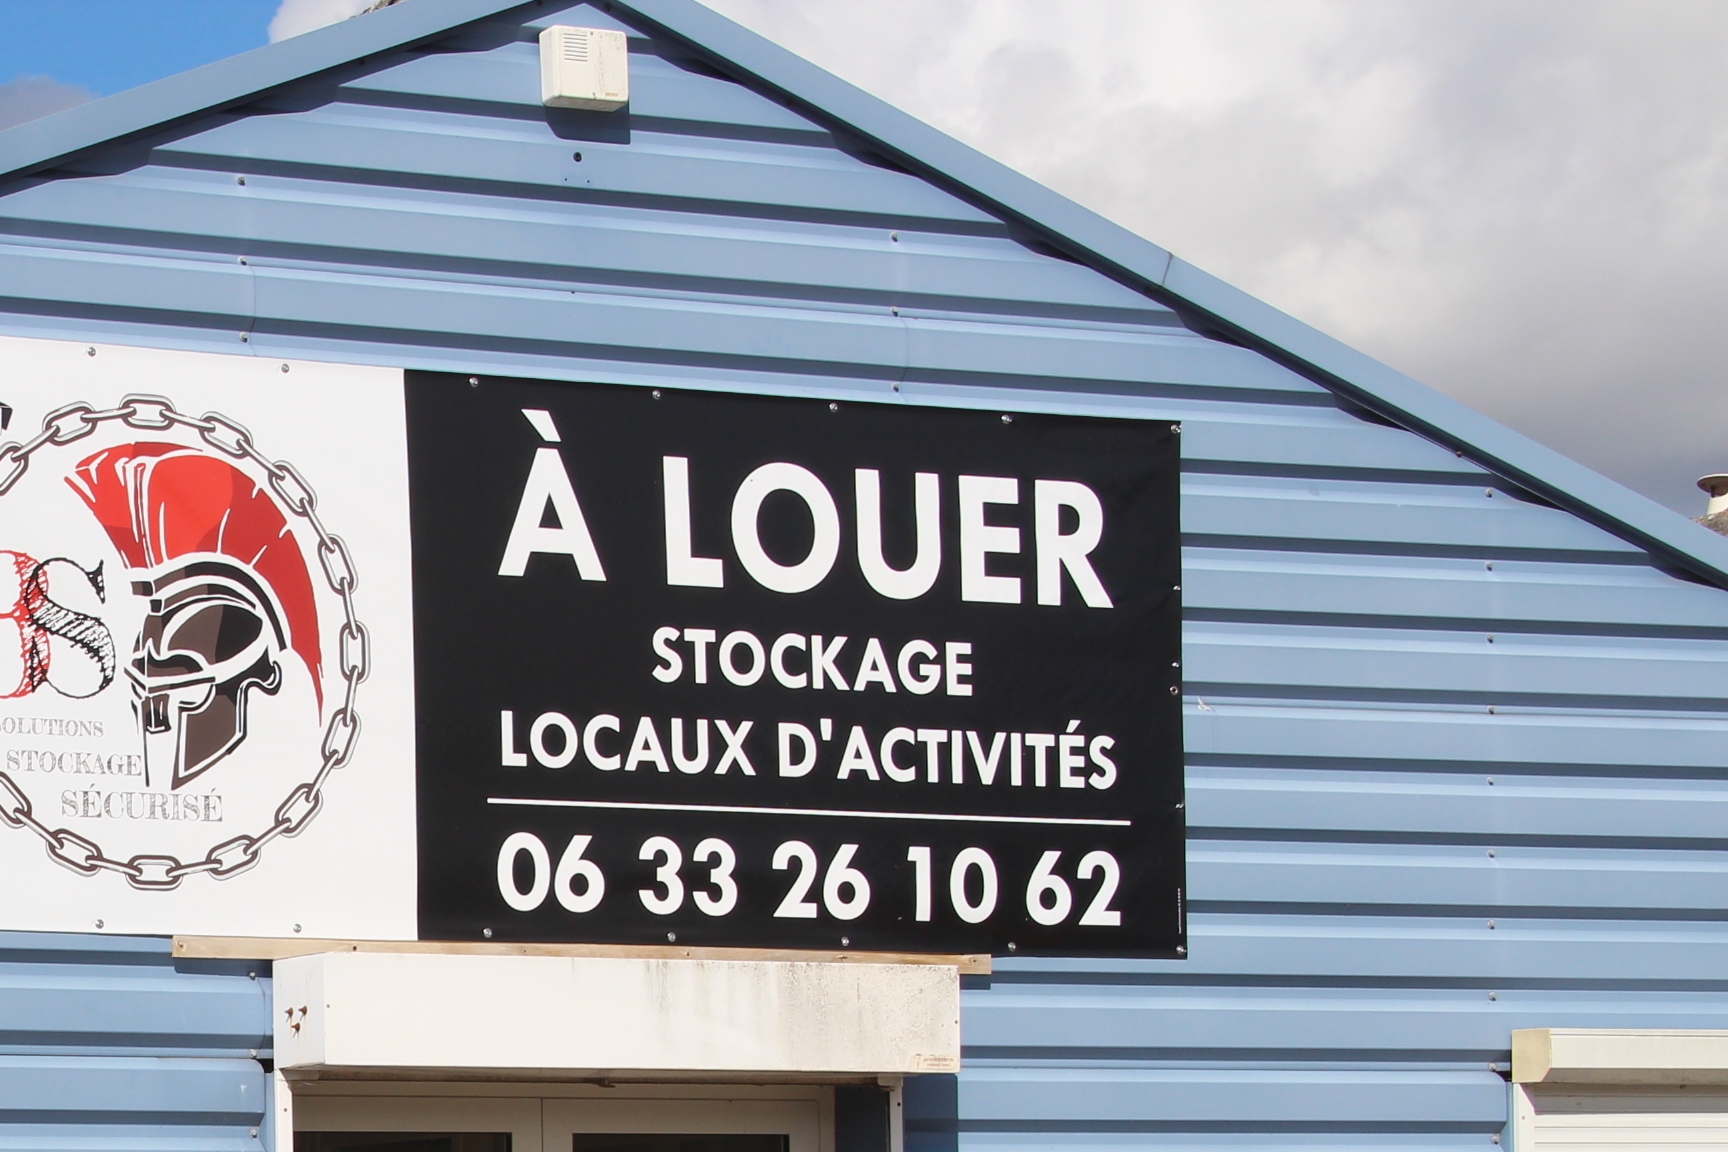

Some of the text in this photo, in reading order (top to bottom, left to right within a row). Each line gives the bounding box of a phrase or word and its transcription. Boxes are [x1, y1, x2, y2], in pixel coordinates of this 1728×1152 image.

[498, 409, 1113, 608] À LOUER
[652, 627, 972, 696] STOCKAGE
[6, 750, 142, 776] STOCKAGE
[501, 711, 1116, 789] LOCAUX D'ACTIVITÉS
[61, 784, 223, 822] SÉCURISÉ
[498, 832, 605, 912] 06
[639, 836, 737, 916] 33
[772, 841, 870, 920] 26
[908, 846, 997, 923] 10
[1026, 851, 1120, 926] 62
